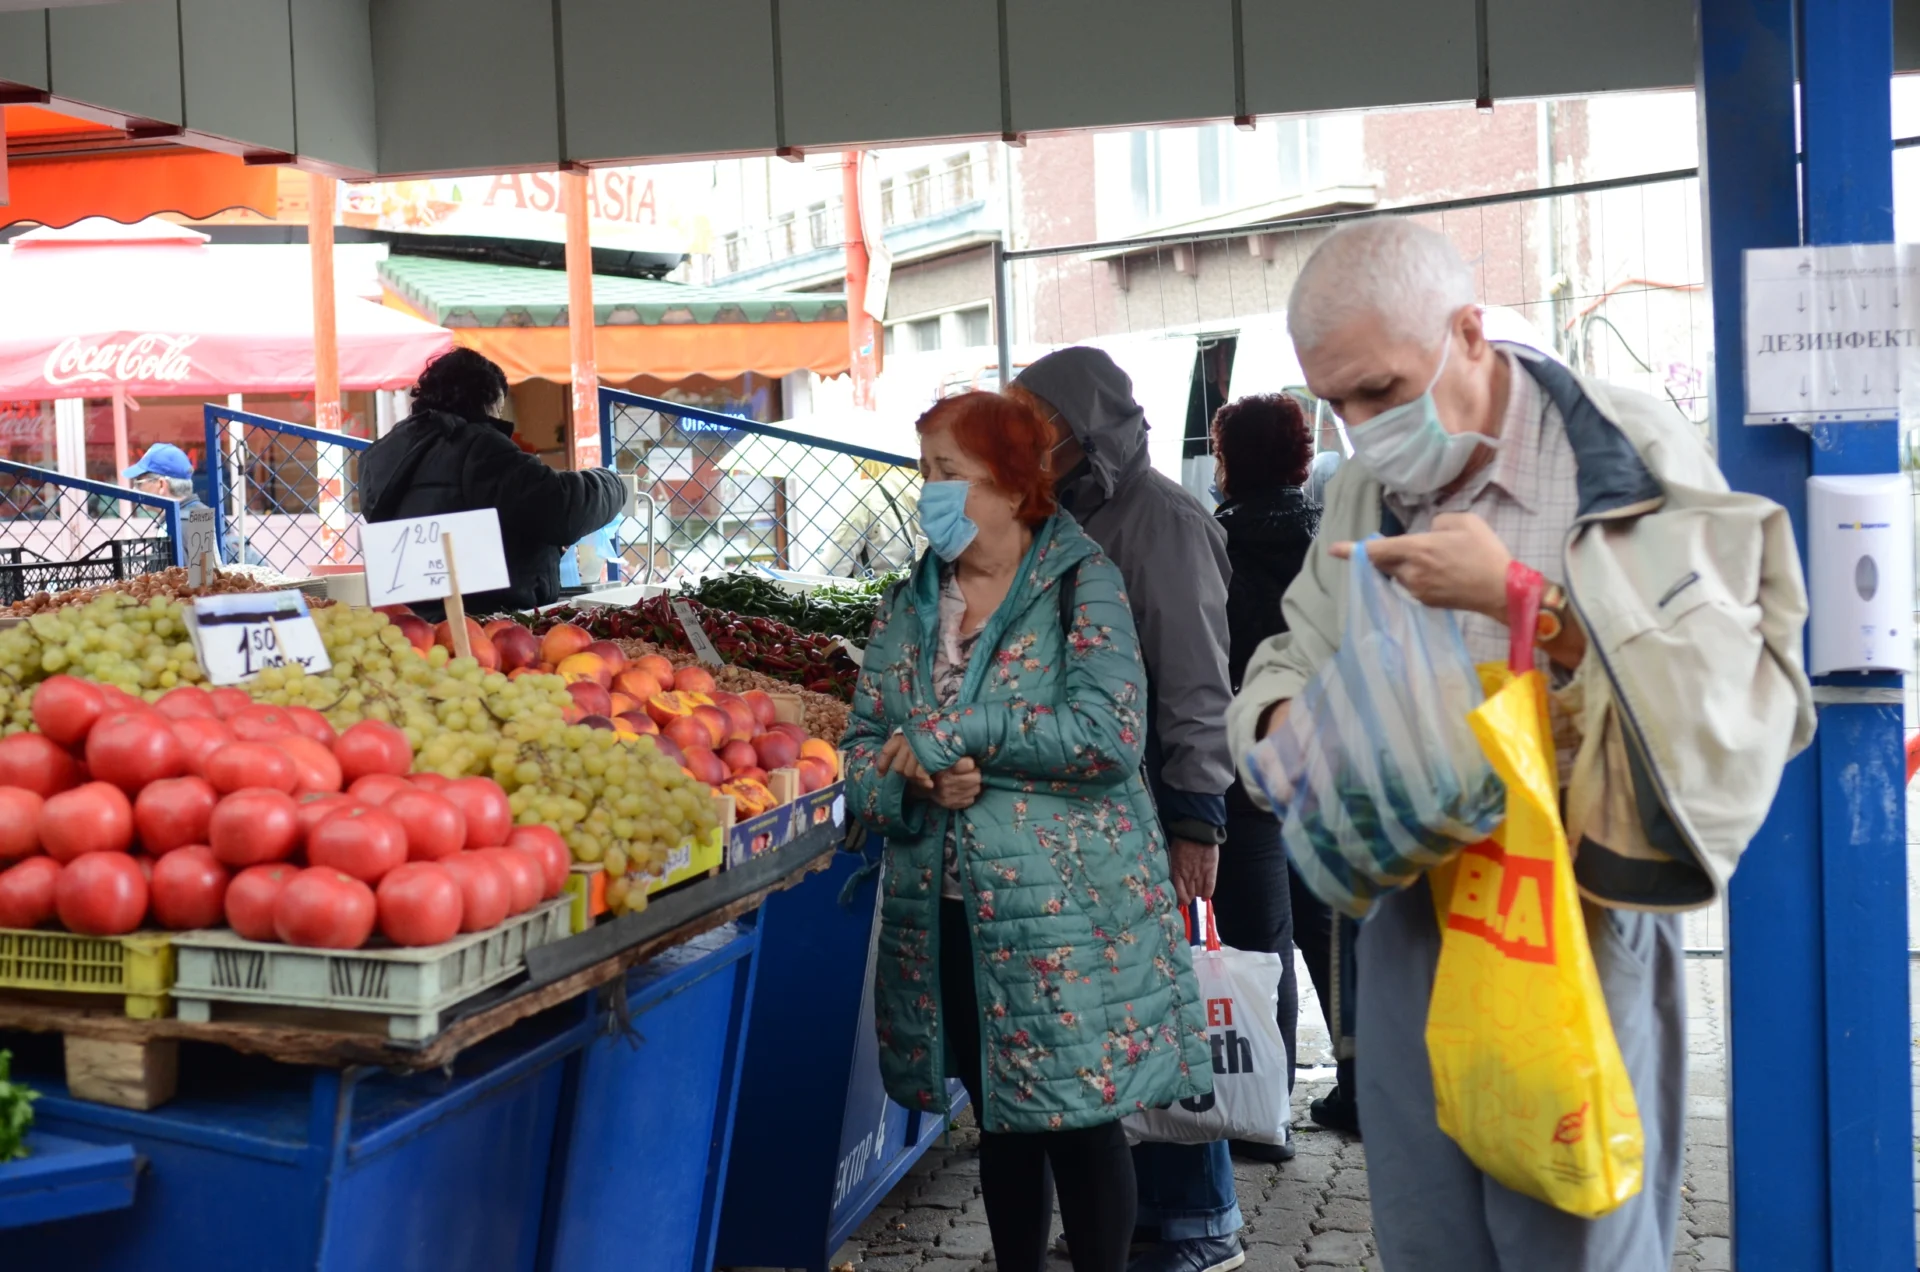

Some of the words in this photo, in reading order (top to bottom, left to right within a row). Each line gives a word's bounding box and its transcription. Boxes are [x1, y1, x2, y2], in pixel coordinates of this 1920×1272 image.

[483, 168, 656, 224] ASASIA
[1757, 328, 1920, 356] ДЕЗИНФЕКТ
[1206, 998, 1234, 1027] ET
